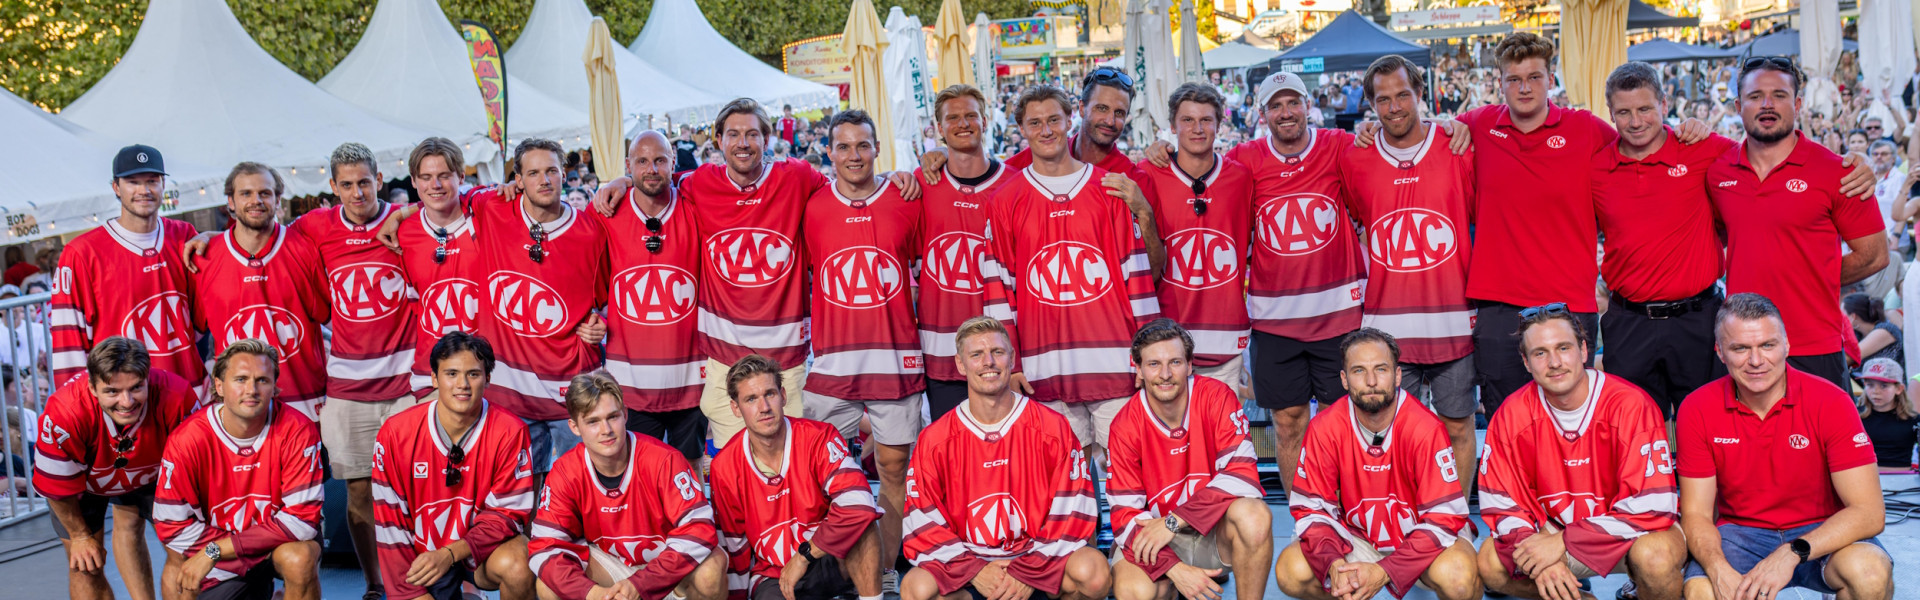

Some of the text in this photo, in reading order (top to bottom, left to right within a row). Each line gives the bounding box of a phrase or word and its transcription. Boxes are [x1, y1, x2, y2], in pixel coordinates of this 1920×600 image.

[1281, 64, 1304, 73] STEREO
[1489, 129, 1508, 139] CCM
[1548, 136, 1565, 148] KAC
[1393, 177, 1419, 185] CCM
[1787, 180, 1806, 192] KAC
[736, 198, 762, 206] CCM
[954, 201, 979, 209] CCM
[6, 213, 25, 226] HOT
[846, 215, 872, 223] CCM
[1049, 209, 1075, 218] CCM
[15, 224, 40, 238] DOGS
[1262, 197, 1333, 252] KAC
[641, 234, 667, 242] CM
[1376, 211, 1446, 268] KAC
[711, 231, 783, 285] KAC
[1167, 231, 1233, 286] KAC
[143, 262, 167, 273] CCM
[1034, 246, 1104, 302] KAC
[51, 266, 73, 295] 90
[243, 275, 268, 283] CCM
[826, 250, 894, 306] KAC
[332, 264, 406, 318] KAC
[616, 268, 689, 321] KAC
[490, 274, 558, 336] KAC
[41, 414, 70, 449] 97
[1170, 442, 1190, 455] CC
[1789, 435, 1808, 449] KAC
[515, 447, 533, 480] 2
[1435, 447, 1459, 483] 8
[1640, 439, 1674, 477] 33
[234, 462, 261, 472] CCM
[1363, 464, 1391, 472] CCM
[674, 468, 702, 500] 8
[601, 504, 628, 513] CCM
[416, 501, 480, 554] KA
